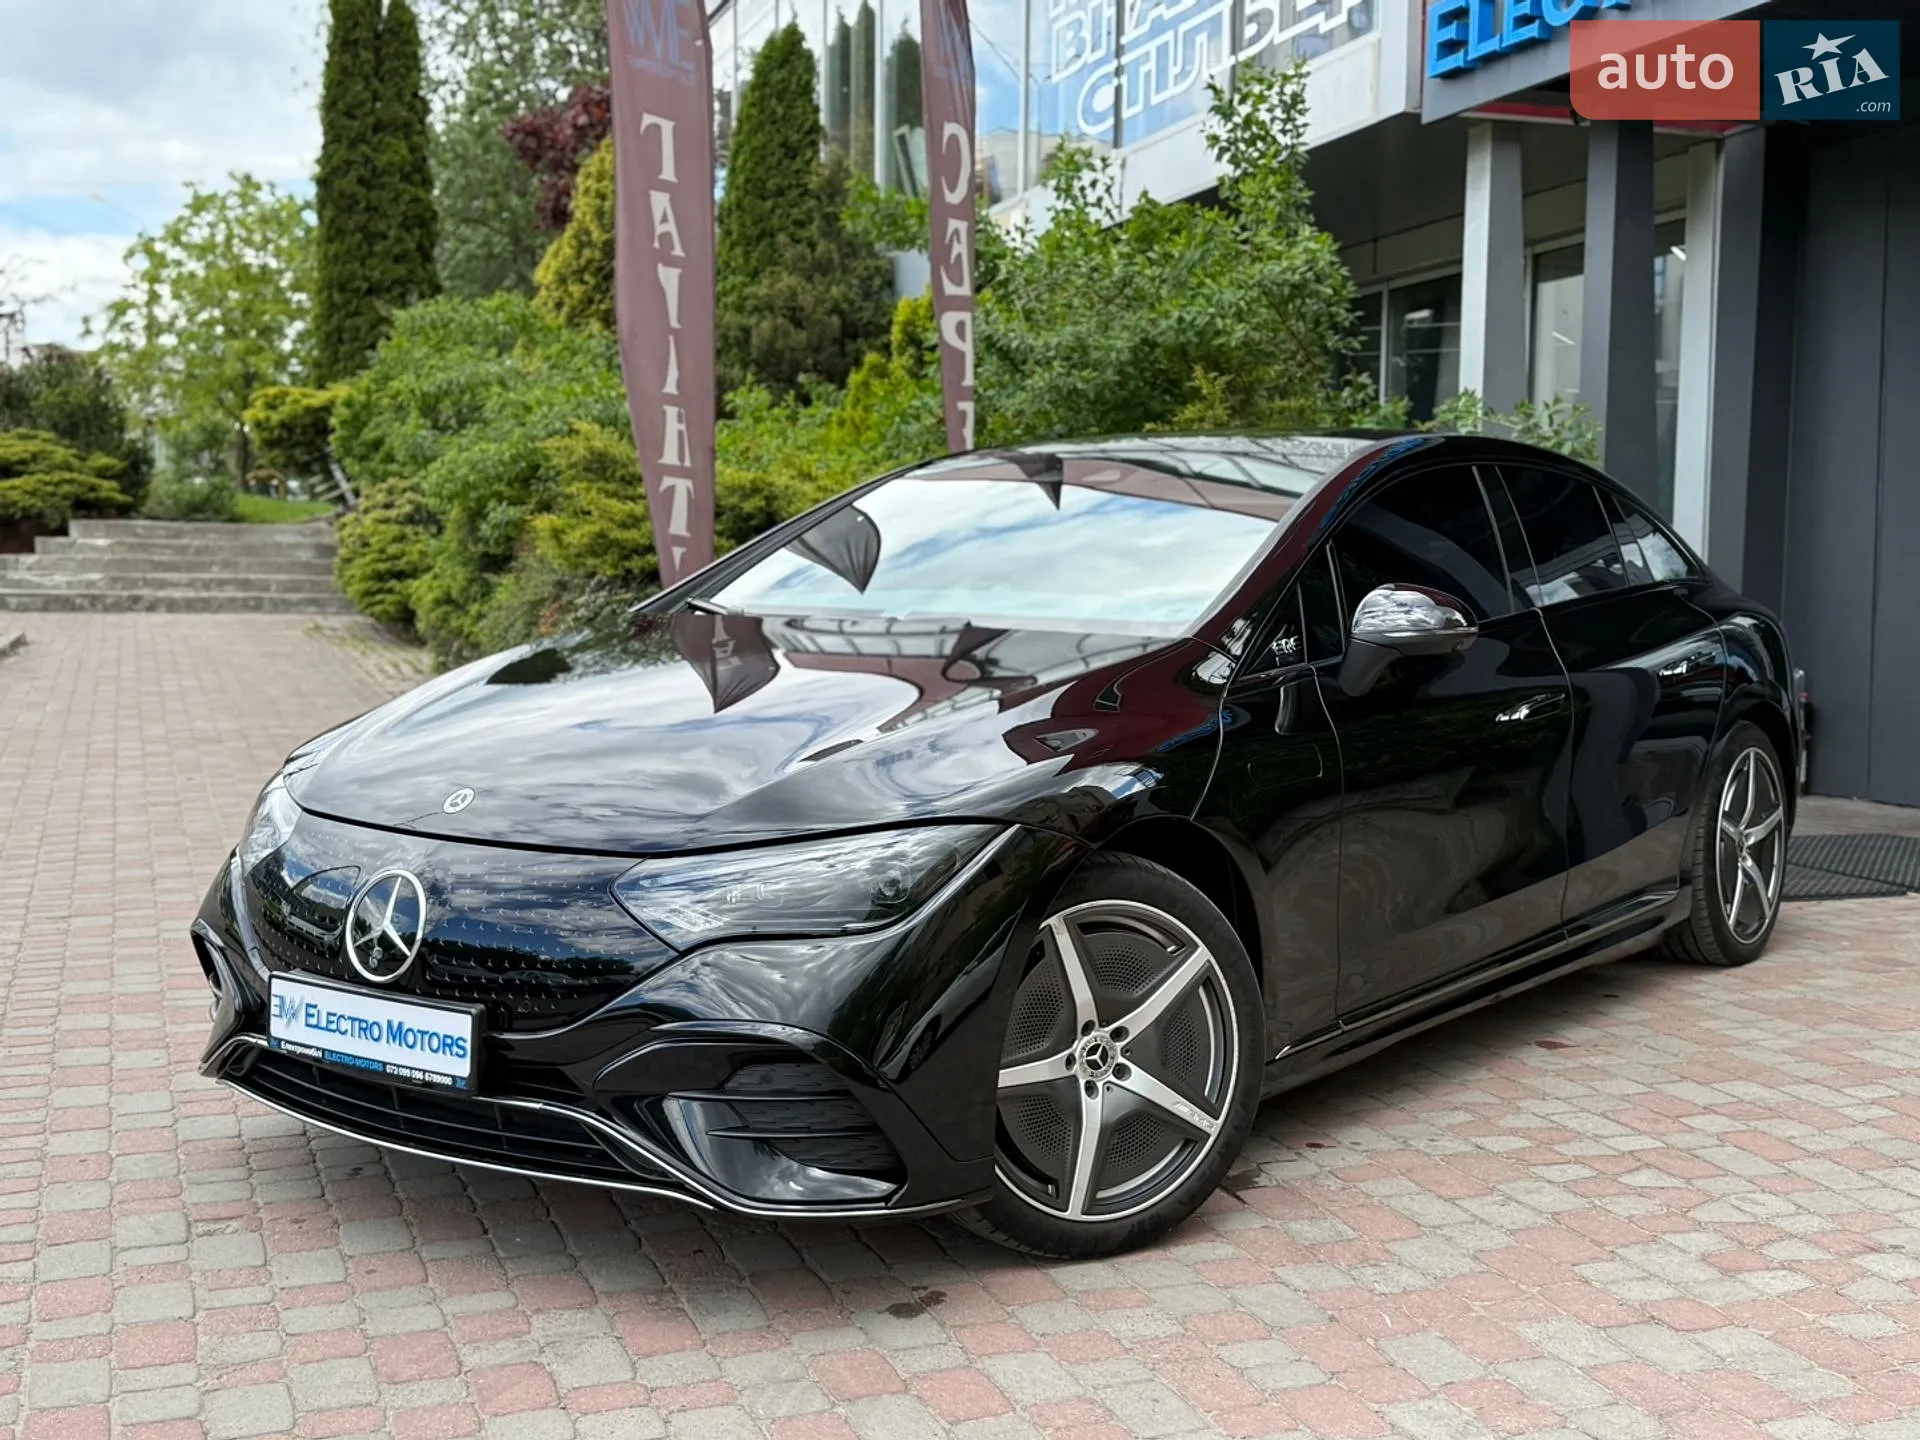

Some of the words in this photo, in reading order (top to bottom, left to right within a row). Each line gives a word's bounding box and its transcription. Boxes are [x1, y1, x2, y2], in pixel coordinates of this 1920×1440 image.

[1428, 0, 1632, 78] ELE
[305, 1003, 384, 1042] ELECTRO
[386, 1019, 467, 1058] MOTORS
